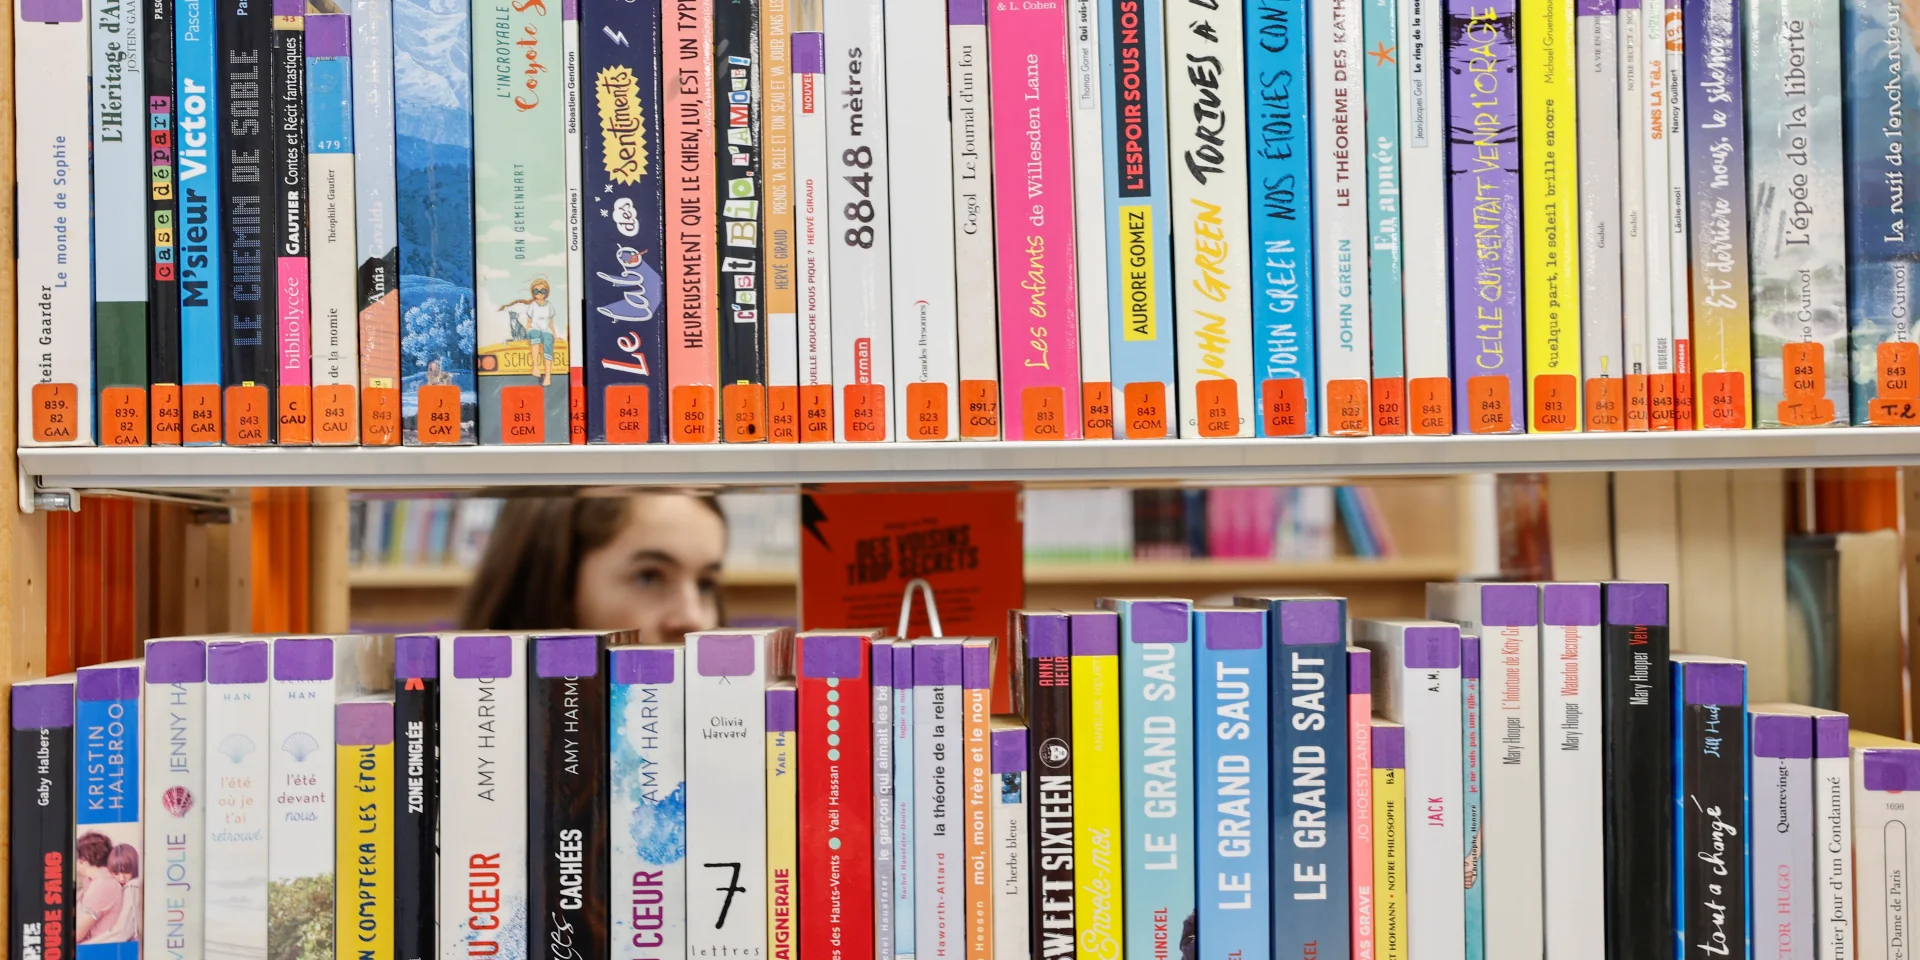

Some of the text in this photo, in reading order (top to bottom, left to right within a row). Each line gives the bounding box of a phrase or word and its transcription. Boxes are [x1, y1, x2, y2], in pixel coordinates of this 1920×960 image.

[100, 41, 125, 143] L'Héritage
[282, 38, 298, 101] fantastiques
[496, 6, 510, 98] L'INCROYABLE
[512, 22, 546, 112] Coyote
[566, 52, 576, 134] Sébastien Gendron
[1121, 1, 1144, 189] L'ESPOIR SOUS NOS
[1468, 6, 1498, 108] L'ORAGE
[283, 104, 298, 131] Récit
[286, 134, 298, 144] et
[840, 47, 875, 250] 8848 mètres
[957, 45, 980, 235] Gogol Le Journal d'un fou
[1333, 49, 1349, 207] LE THÉORÈME DES
[1472, 114, 1499, 172] VENIR
[1785, 20, 1813, 246] L'épée de la liberté
[1882, 1, 1904, 242] La nuit de l'enchanteur
[54, 136, 67, 288] Le monde de Sophie
[152, 98, 172, 278] case départ
[180, 78, 208, 307] M'sieur Victor
[230, 49, 262, 346] LE CHEMIN DE SABLE
[285, 148, 299, 185] Contes
[326, 169, 336, 243] Théophile Gautier
[513, 163, 525, 260] DAN GEMEINHART
[678, 39, 703, 348] HEUREUSEMENT QUE LE CHIEN, LUI, EST UN
[1020, 54, 1050, 369] Les enfants de Willesden Lane
[1702, 37, 1737, 308] Et derrière nous, le silence
[597, 71, 653, 375] Le labo des sentiments
[1473, 176, 1501, 260] SENTAIT
[1544, 99, 1560, 368] Quelque part, le soleil brille encore
[1129, 211, 1148, 335] AURORE GOMEZ
[1190, 198, 1230, 378] JOHN GREEN
[1265, 239, 1300, 379] JOHN GREEN
[283, 277, 304, 369] bibliolycée
[1475, 305, 1503, 369] CELLE
[44, 401, 68, 410] 839.
[44, 427, 69, 436] GAA
[50, 414, 63, 423] 82
[280, 414, 306, 424] GAU
[289, 401, 297, 410] C
[429, 425, 452, 435] GAY
[431, 412, 450, 421] 843
[511, 426, 535, 436] GEM
[514, 413, 531, 422] 813
[684, 425, 705, 434] GHI
[685, 411, 704, 421] 850
[853, 422, 875, 432] EDG
[854, 409, 873, 418] 843
[1713, 396, 1732, 405] 843
[1713, 408, 1734, 418] GUI
[1881, 405, 1916, 419] T.2
[1501, 638, 1523, 765] Mary Hooper L'Infortune de Kitty
[88, 726, 104, 809] KRISTIN
[406, 721, 423, 813] ZONE CINGLÉE
[828, 766, 839, 832] Yaël Hassan
[876, 705, 893, 861] le garçon qui aimait les
[932, 726, 945, 836] la théorie de la
[1216, 662, 1251, 910] LE GRAND SAUT
[1291, 652, 1327, 900] LE GRAND SAUT
[1356, 722, 1369, 842] JO HOESTLANDT
[1428, 797, 1443, 826] JACK
[1886, 803, 1904, 811] 1698
[1006, 819, 1018, 895] L'herbe bleue
[1040, 775, 1073, 870] SIXTEEN
[1828, 777, 1847, 926] Jour d'un Condamné
[469, 853, 501, 929] CŒUR
[556, 829, 583, 910] CACHÉES
[633, 870, 663, 948] CŒUR
[704, 863, 746, 929] 7
[936, 852, 946, 956] Haworth-Attard
[1080, 827, 1119, 960] Envole-moi
[1691, 795, 1736, 956] tout a changé
